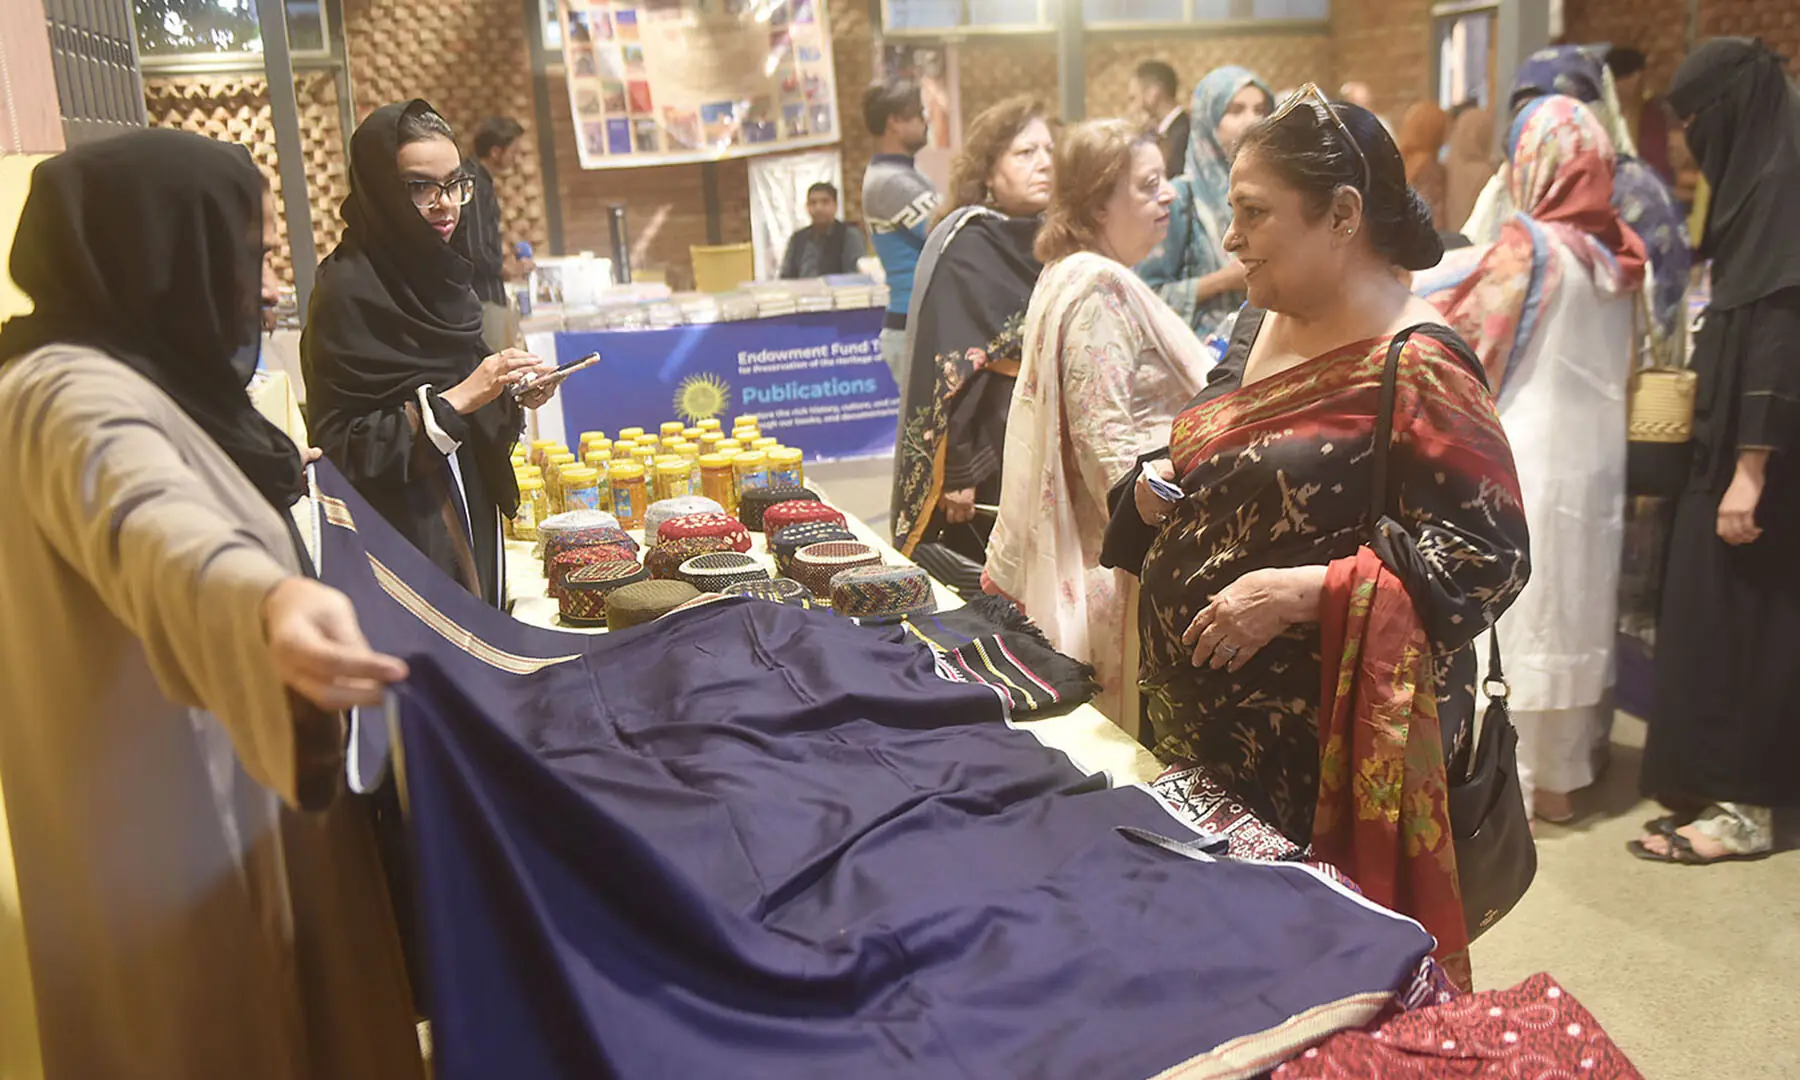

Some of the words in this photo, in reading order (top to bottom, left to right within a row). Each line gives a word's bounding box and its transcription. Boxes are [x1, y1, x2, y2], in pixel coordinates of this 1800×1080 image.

[738, 344, 828, 365] Endowment
[831, 340, 868, 355] Fund
[871, 338, 880, 353] T
[738, 366, 751, 375] for
[753, 361, 808, 374] Preservation
[742, 377, 877, 405] Publications
